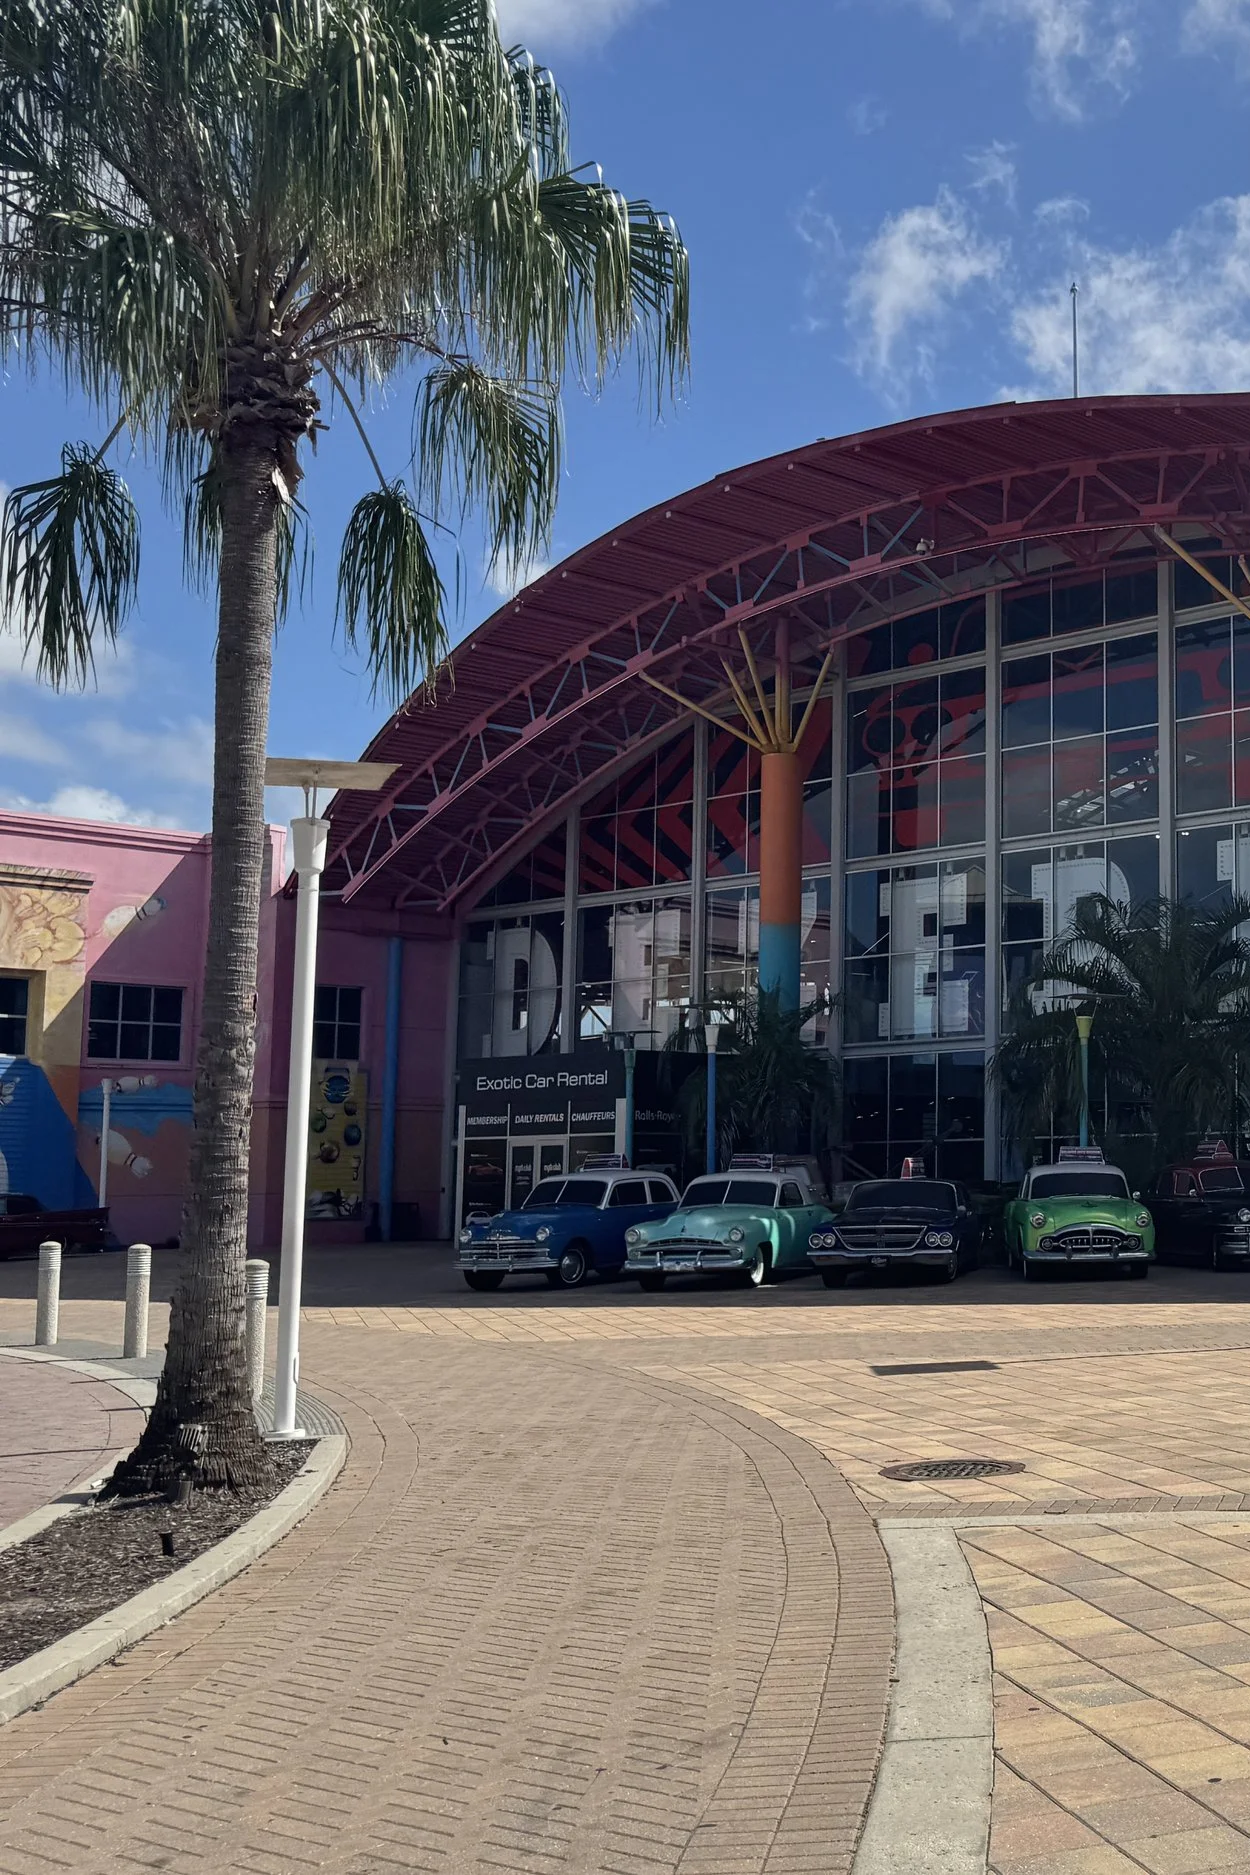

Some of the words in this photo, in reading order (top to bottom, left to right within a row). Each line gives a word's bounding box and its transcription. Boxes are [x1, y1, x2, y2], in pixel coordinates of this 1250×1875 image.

[476, 1076, 522, 1091] Exotic
[525, 1074, 555, 1089] Car
[557, 1070, 608, 1088] Rental
[467, 1115, 508, 1126] MEMBERSHIP
[514, 1115, 534, 1124] DAILY
[534, 1112, 565, 1123] RENTALS
[571, 1111, 616, 1122] CHAUFFEURS
[634, 1109, 682, 1124] Rolls-Roy
